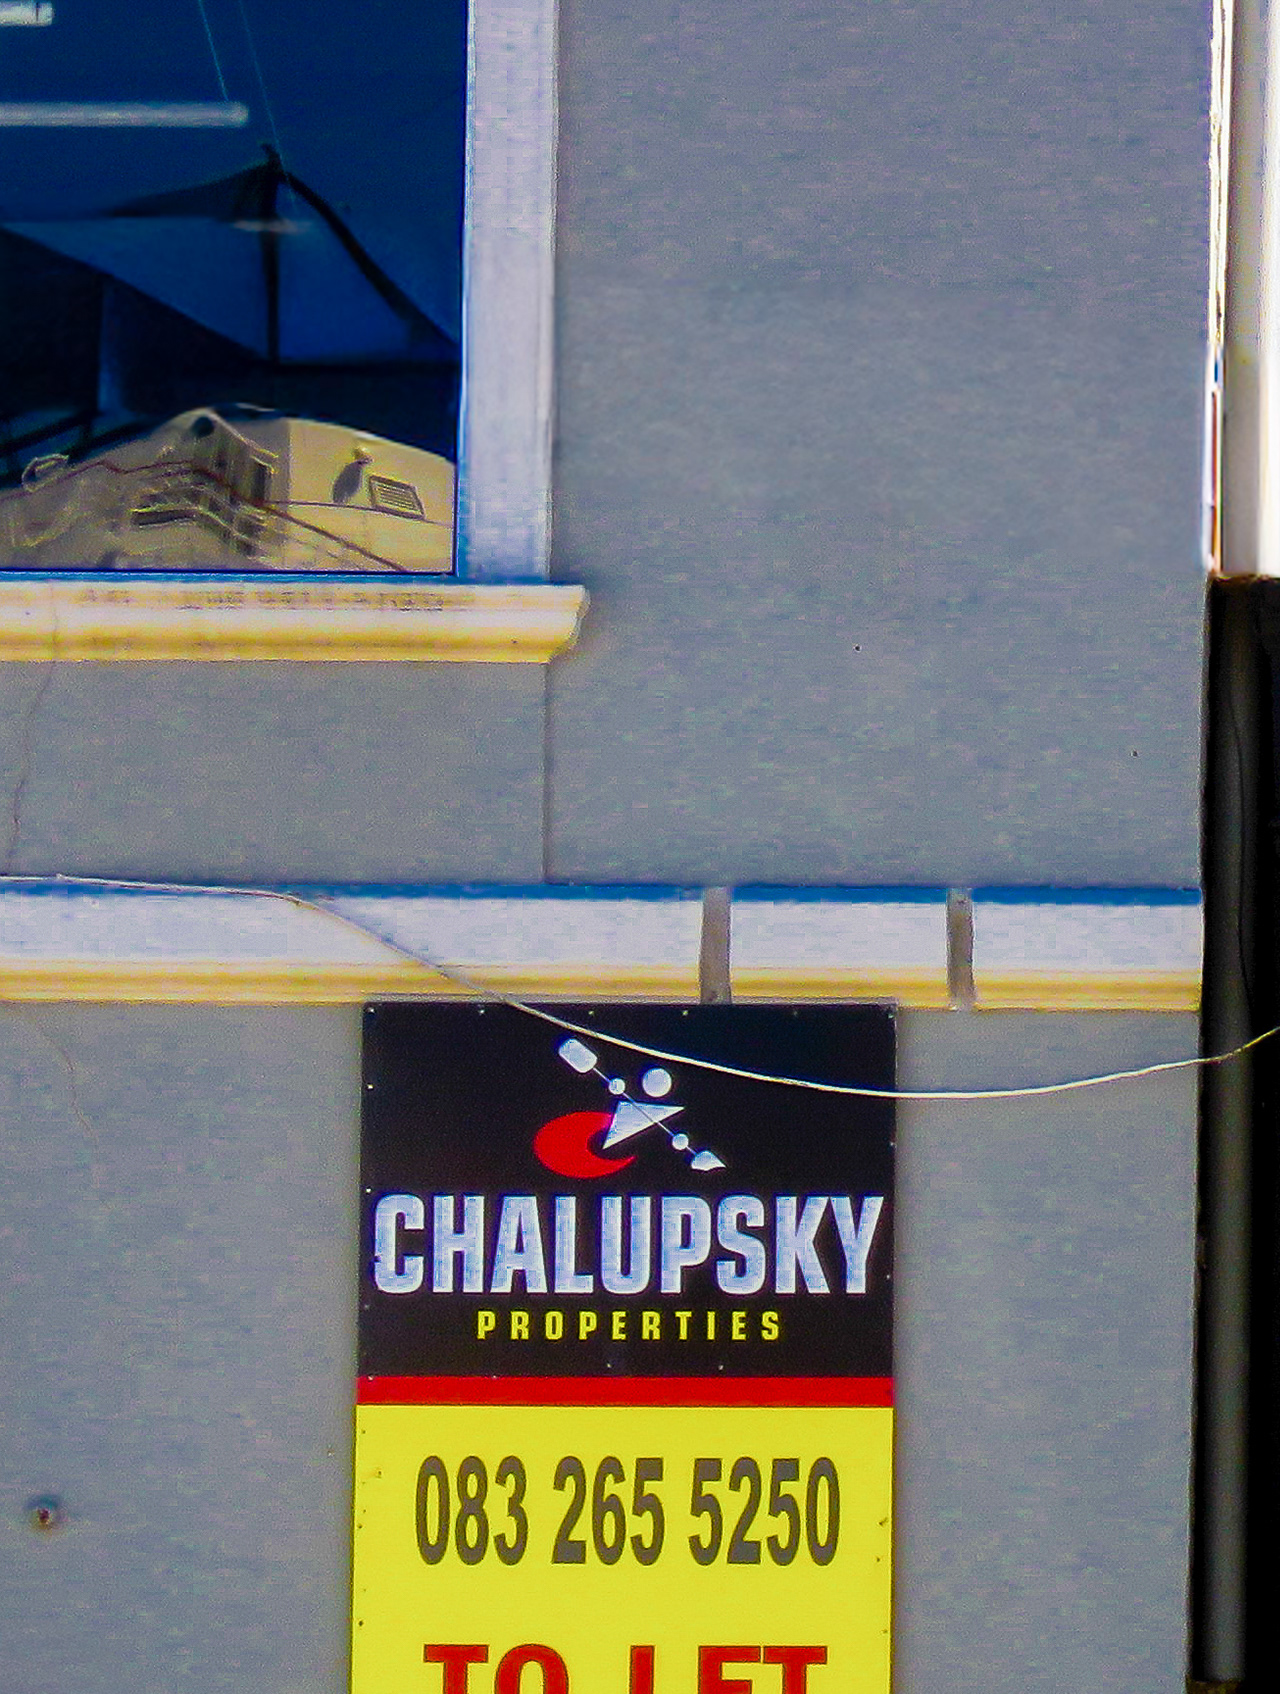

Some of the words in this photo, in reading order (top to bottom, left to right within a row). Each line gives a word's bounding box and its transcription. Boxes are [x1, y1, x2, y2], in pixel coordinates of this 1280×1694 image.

[374, 1193, 885, 1296] CHALUPSKY
[476, 1310, 781, 1342] PROPERTIES
[415, 1455, 529, 1567] 083
[551, 1455, 666, 1567] 265
[688, 1456, 841, 1567] 5250
